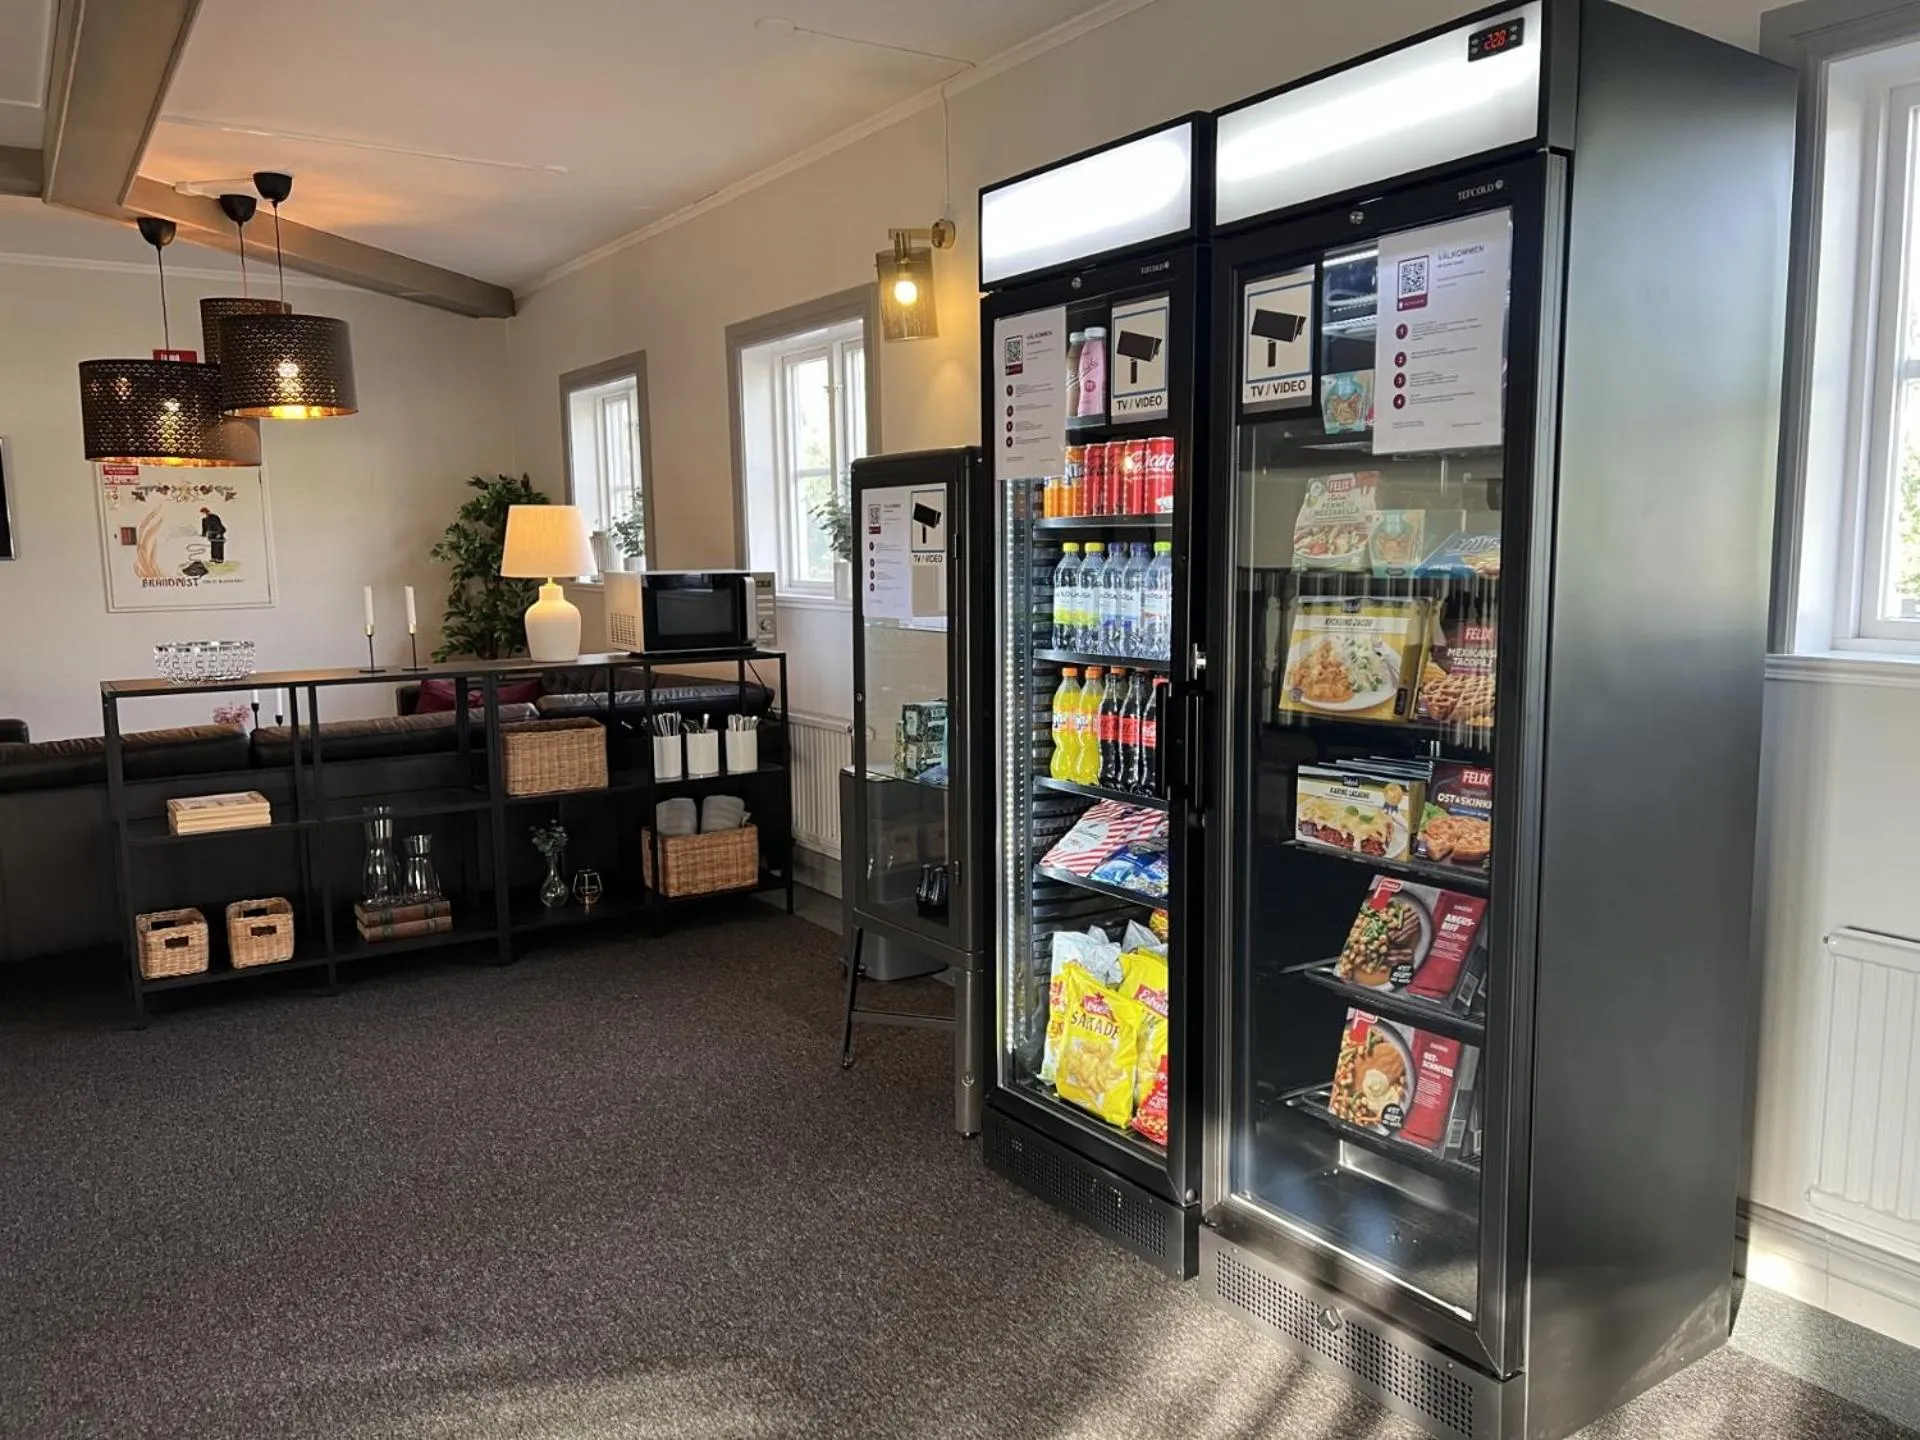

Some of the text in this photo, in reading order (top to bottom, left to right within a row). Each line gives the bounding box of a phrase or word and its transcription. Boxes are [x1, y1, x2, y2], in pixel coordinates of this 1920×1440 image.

[1458, 184, 1494, 200] TEFCOLD
[1250, 384, 1264, 397] TV
[1273, 379, 1306, 394] VIDEO
[1117, 400, 1128, 410] TV
[1135, 395, 1163, 408] VIDEO
[1328, 480, 1352, 492] FELIX
[926, 554, 943, 563] VIDEO
[1465, 627, 1494, 640] FELIX
[1463, 771, 1490, 786] FELIX
[1138, 989, 1168, 1017] Estrell
